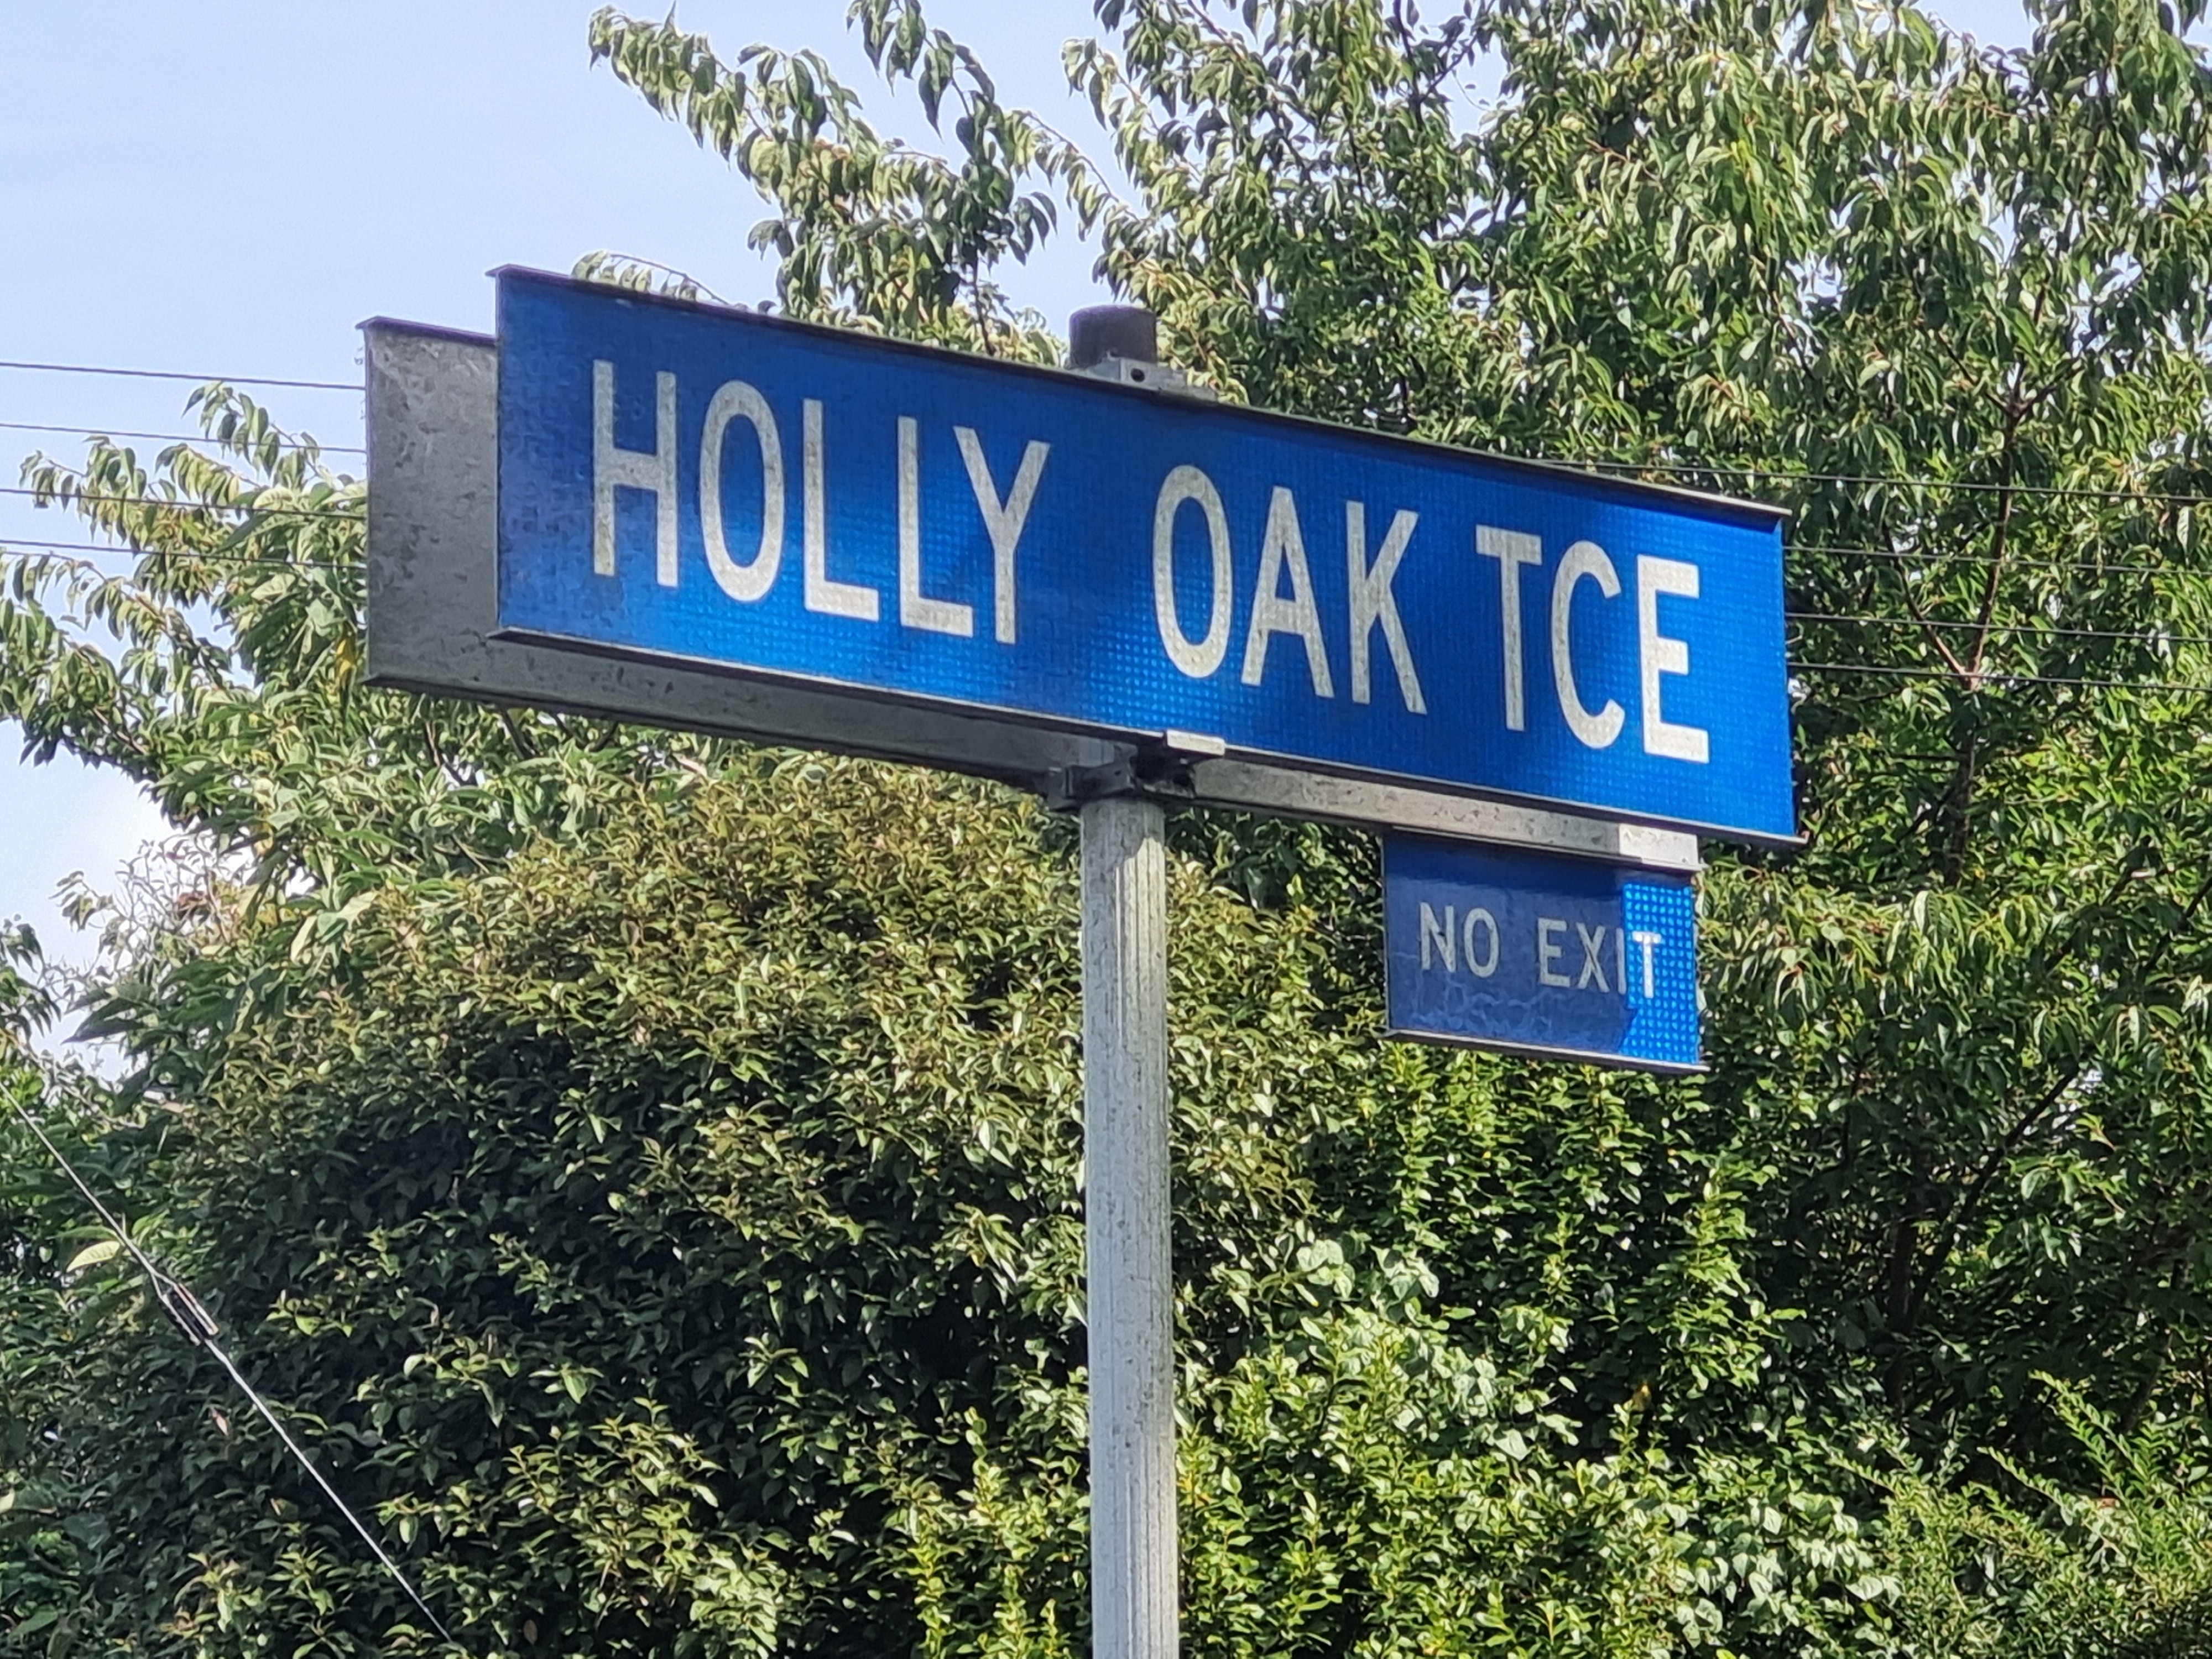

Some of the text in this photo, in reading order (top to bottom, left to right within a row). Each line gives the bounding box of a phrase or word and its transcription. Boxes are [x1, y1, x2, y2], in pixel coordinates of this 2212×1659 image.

[592, 358, 1709, 764] HOLLY OAK TCE
[1420, 902, 1661, 998] NO EXIT
